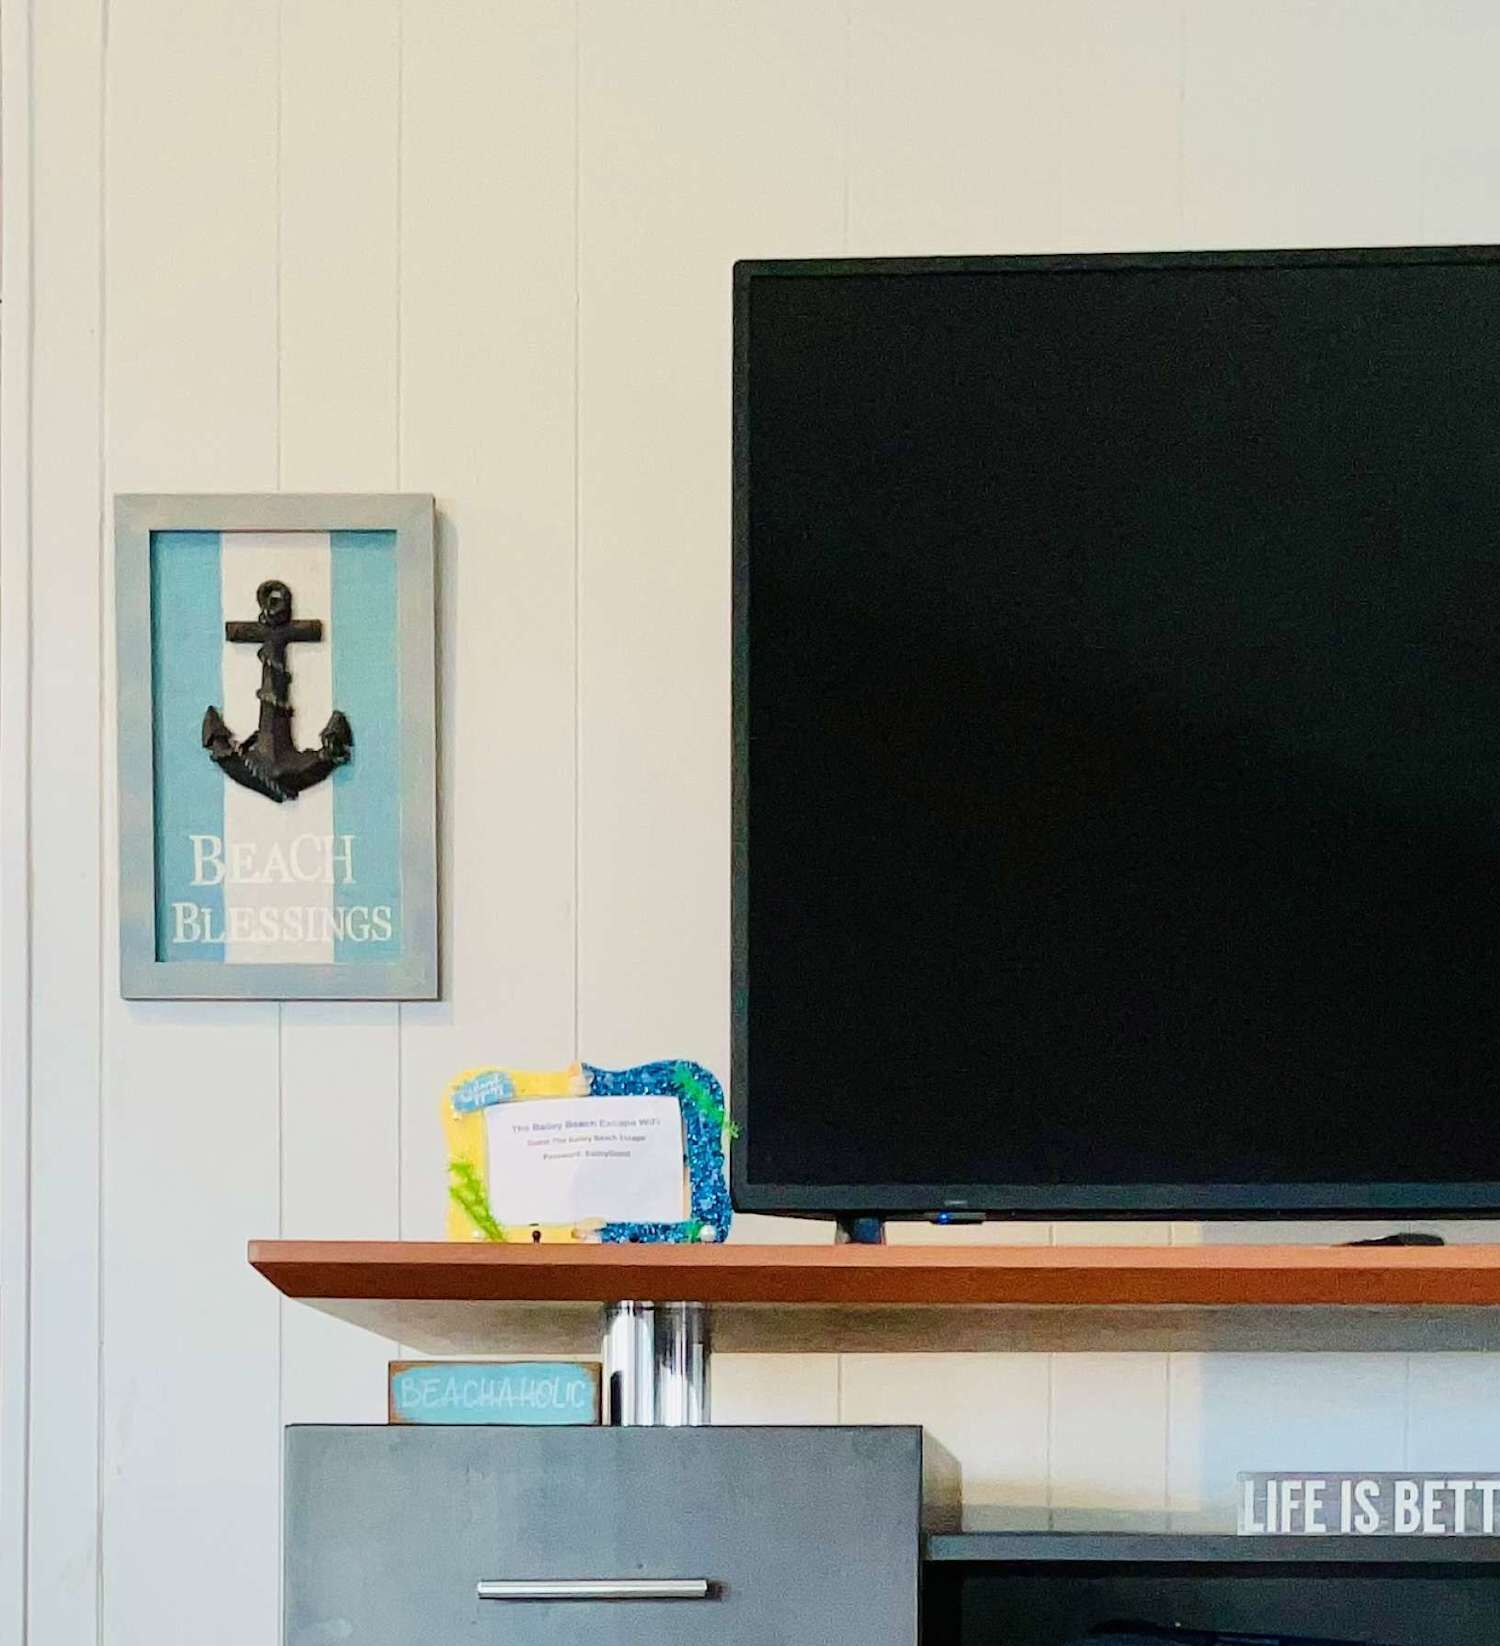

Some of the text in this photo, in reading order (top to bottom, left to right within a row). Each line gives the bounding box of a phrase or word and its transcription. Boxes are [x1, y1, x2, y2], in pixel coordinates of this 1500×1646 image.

[190, 833, 356, 886] BEACH
[172, 902, 393, 944] BLESSINGS
[400, 1375, 586, 1409] BEACHAHOLIC
[1244, 1480, 1326, 1535] LIFE
[1341, 1480, 1380, 1535] IS
